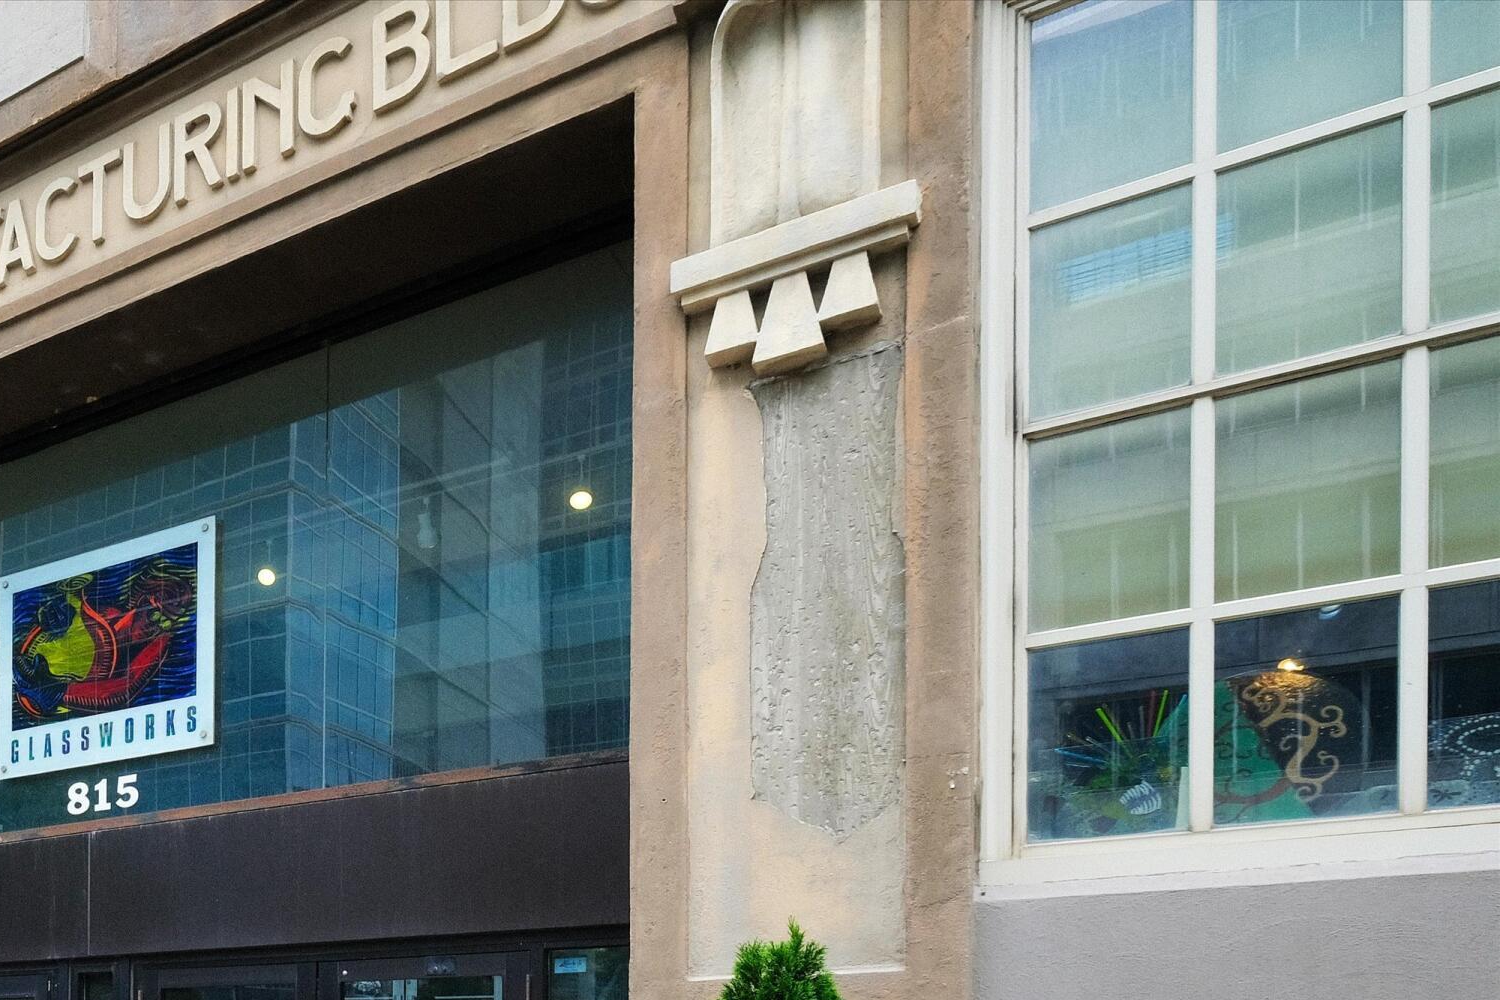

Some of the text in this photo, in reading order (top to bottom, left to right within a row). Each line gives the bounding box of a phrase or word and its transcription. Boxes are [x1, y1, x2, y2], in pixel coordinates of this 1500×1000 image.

[371, 0, 622, 112] BLD
[11, 705, 198, 764] GLASSWORKS
[66, 773, 140, 816] 815
